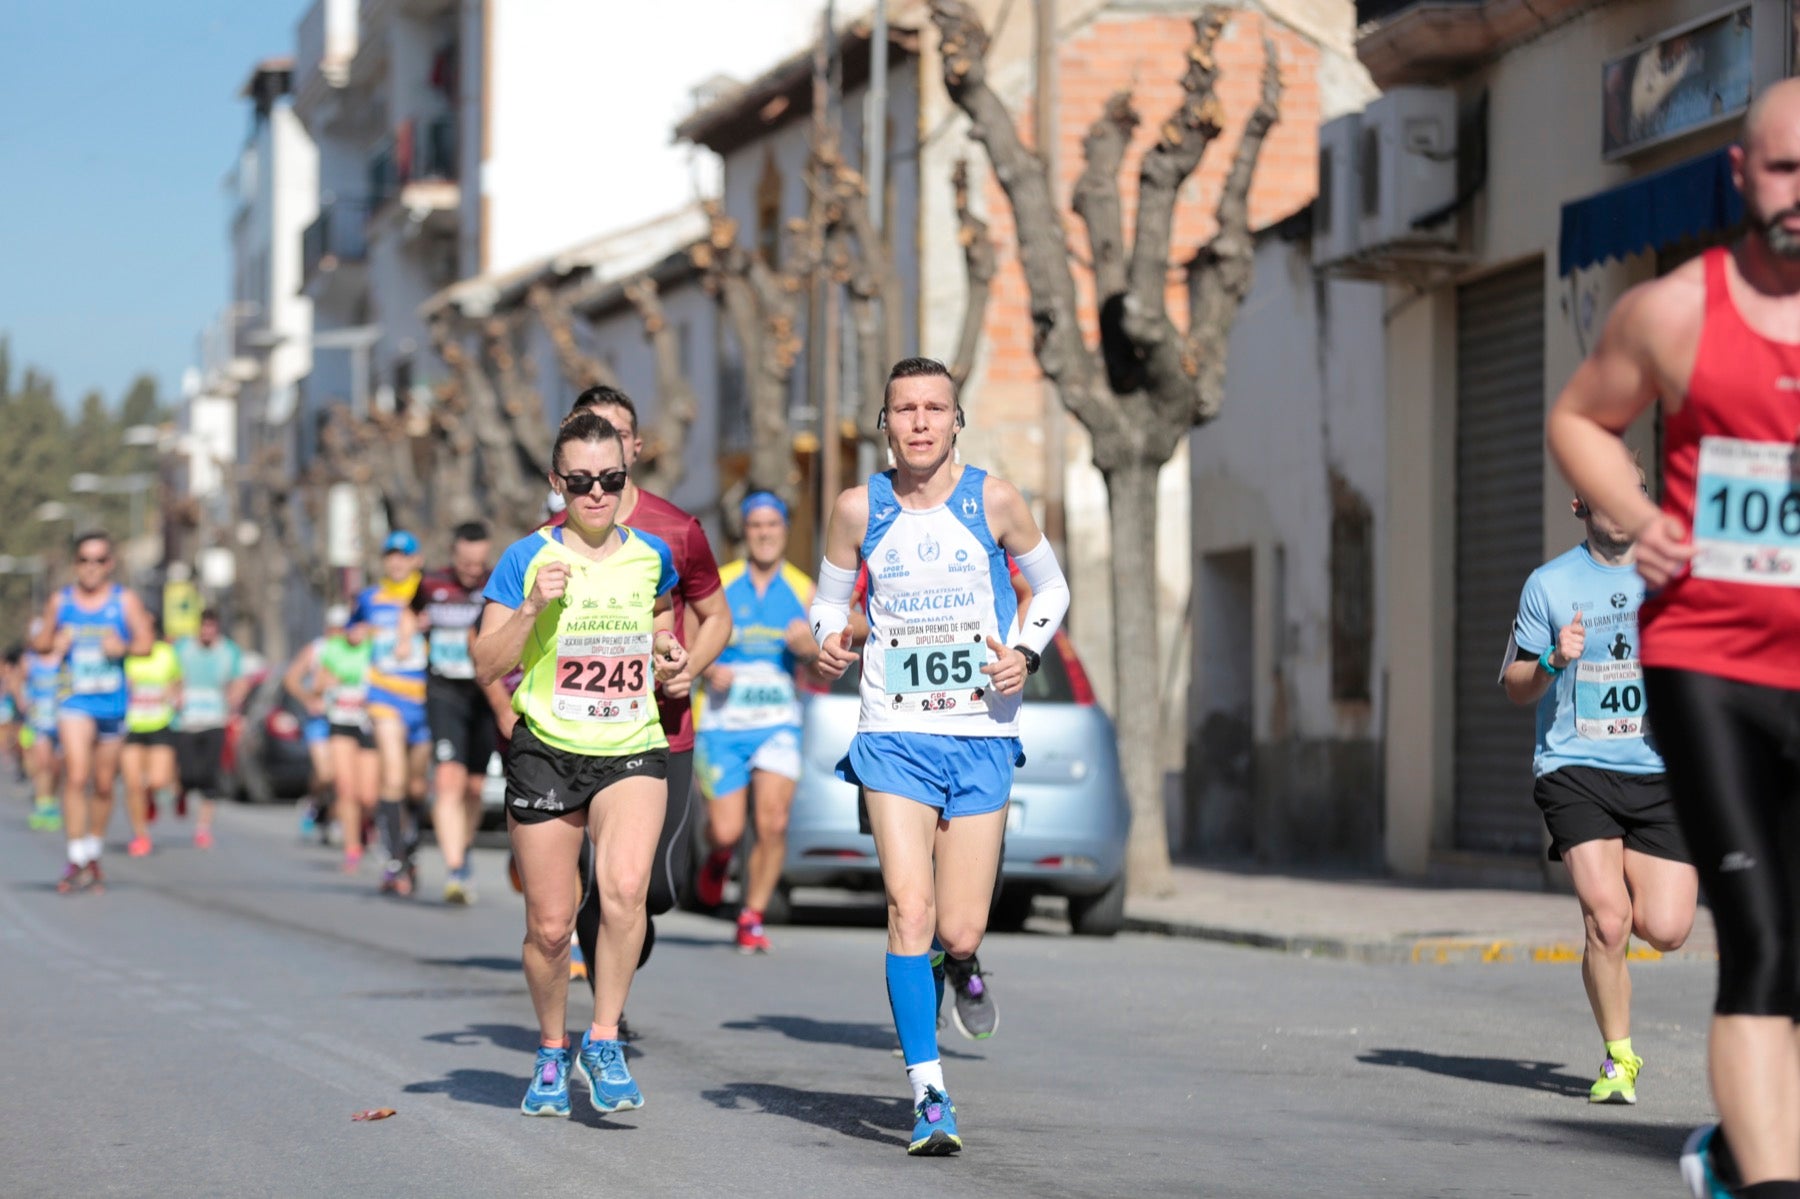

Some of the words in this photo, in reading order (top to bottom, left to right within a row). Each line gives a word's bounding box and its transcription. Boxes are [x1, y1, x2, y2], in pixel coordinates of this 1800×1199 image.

[883, 564, 904, 572] SPORT
[884, 592, 975, 612] MARACENA
[566, 620, 638, 632] MARACENA
[1593, 614, 1611, 627] GRAN
[907, 625, 924, 636] GRAN
[925, 623, 949, 634] PREMIO
[951, 622, 959, 632] DE
[960, 621, 980, 631] FONDO
[584, 636, 600, 646] GRAN
[602, 634, 623, 645] PREMIO
[624, 634, 631, 645] DE
[903, 650, 972, 686] 165
[1610, 662, 1632, 671] PREMIO
[560, 659, 643, 693] 2243
[1600, 685, 1641, 713] 40
